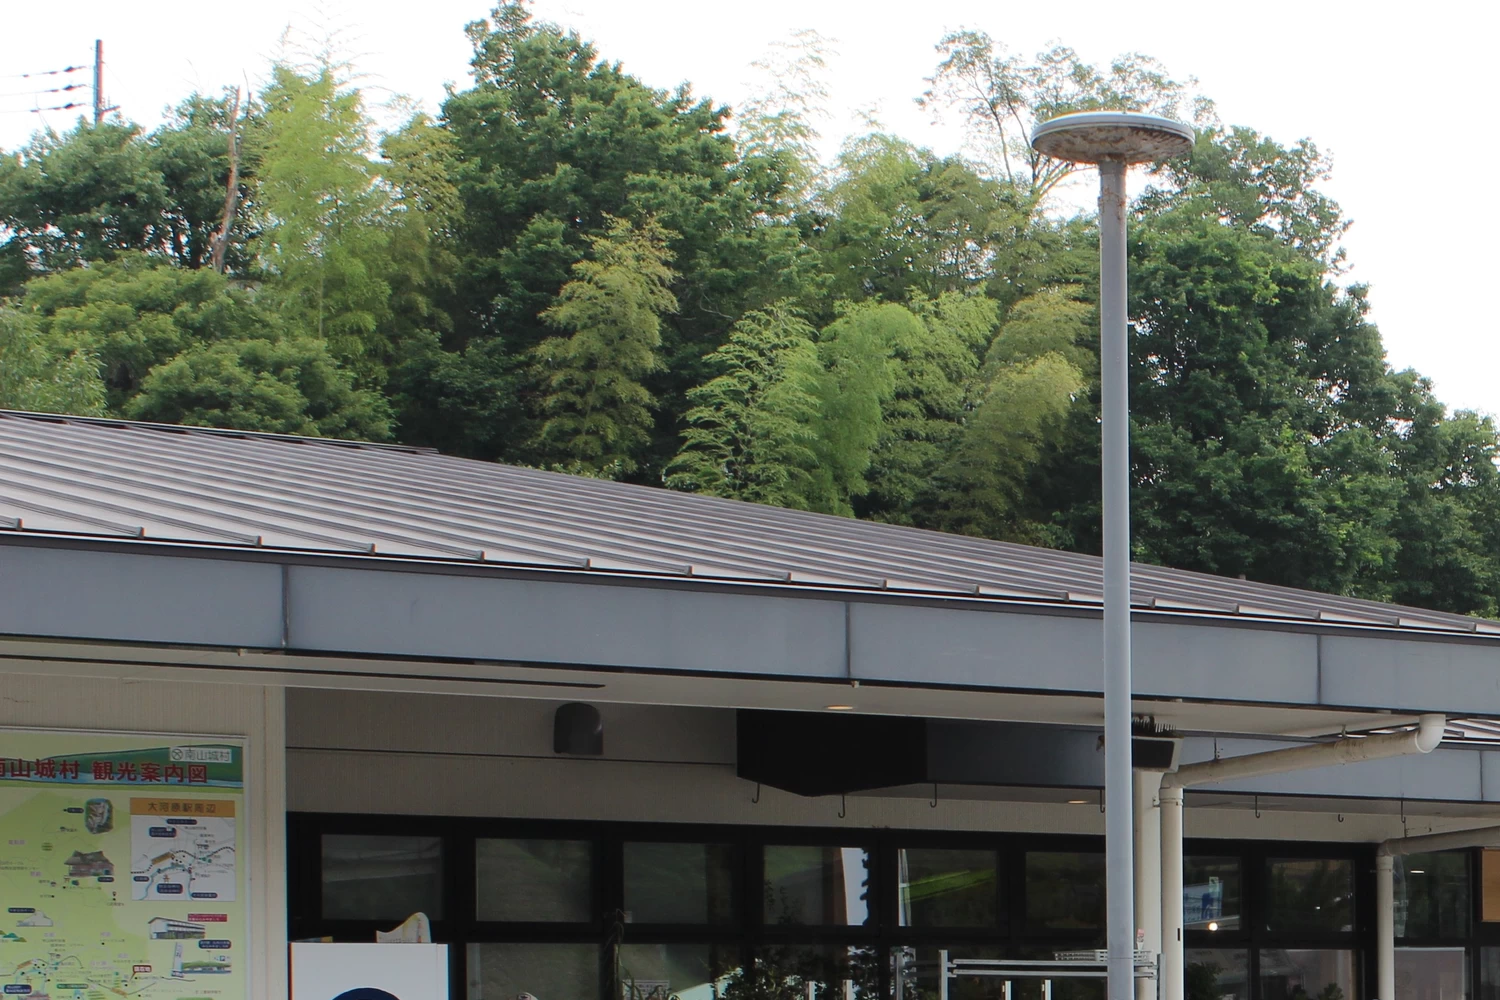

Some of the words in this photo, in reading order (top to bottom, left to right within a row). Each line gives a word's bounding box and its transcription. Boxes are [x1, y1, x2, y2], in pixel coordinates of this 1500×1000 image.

[184, 748, 230, 761] 南山城村
[0, 758, 80, 779] 山城村
[92, 761, 207, 783] 観光案内図
